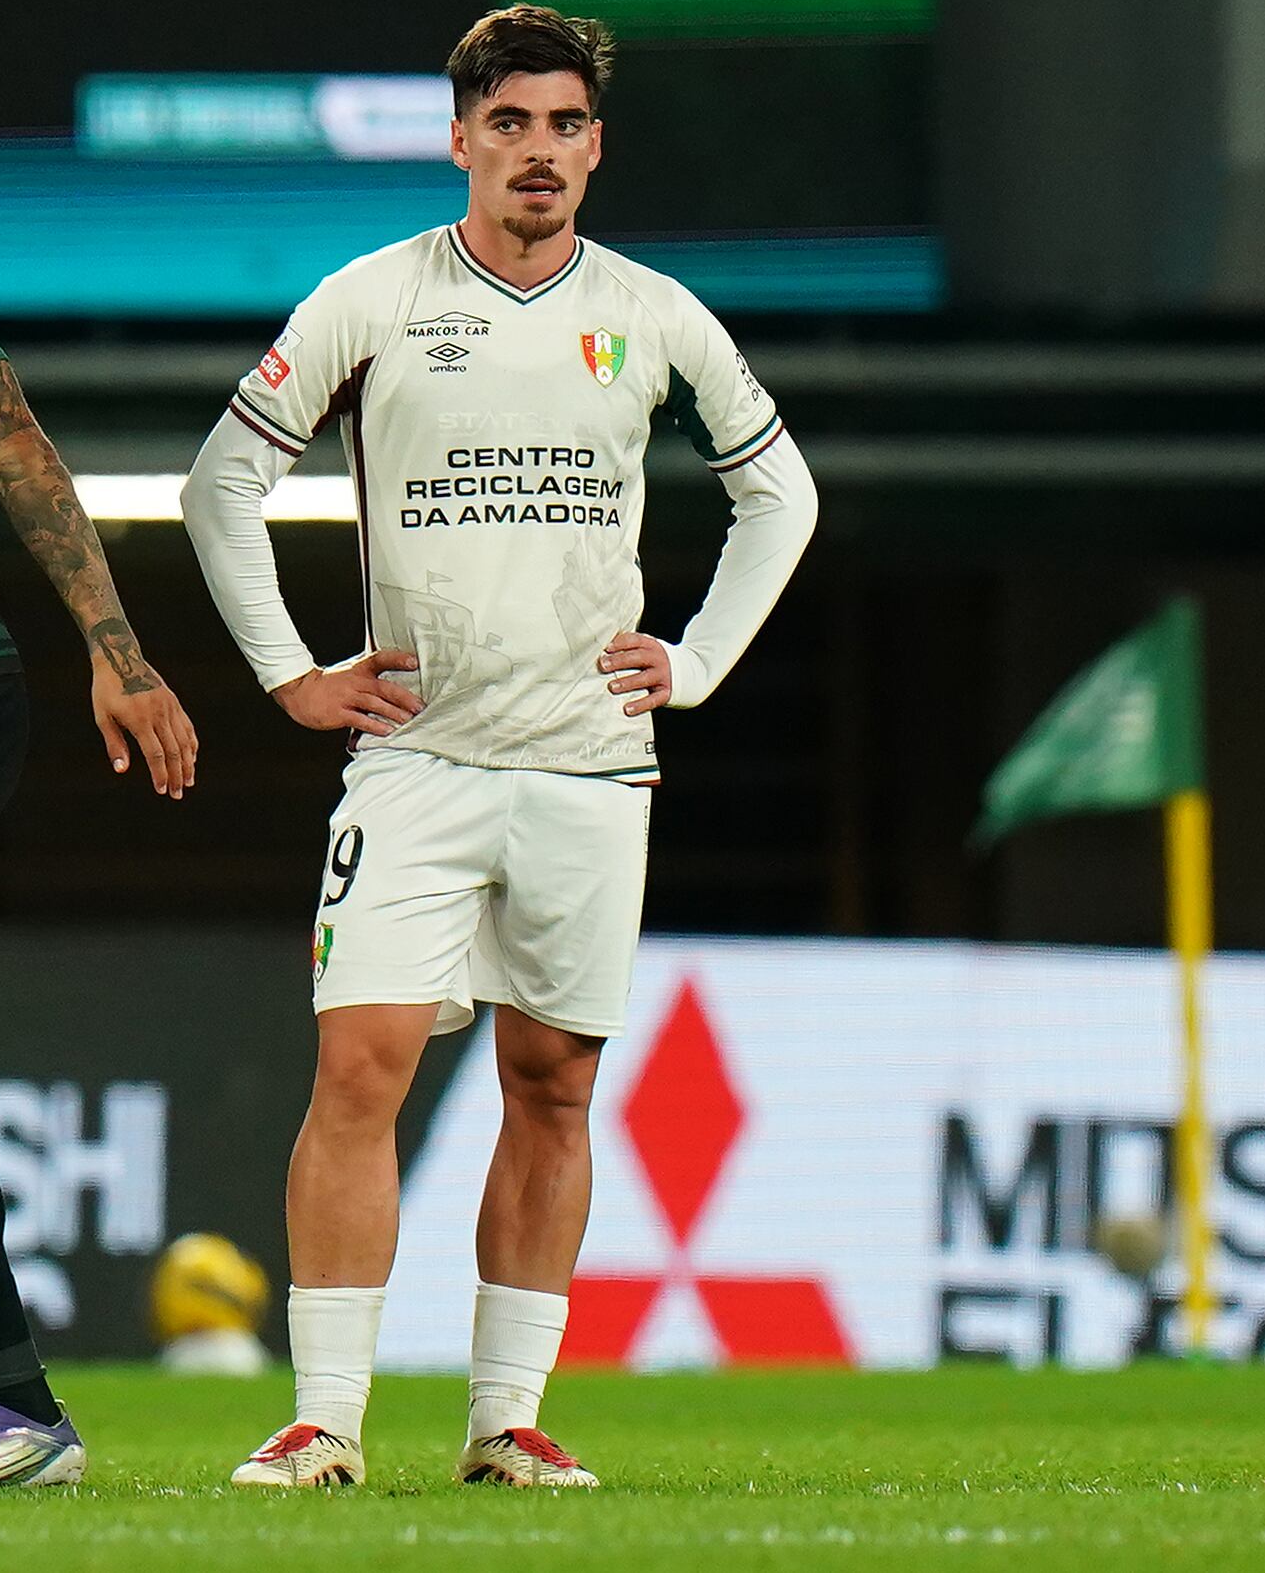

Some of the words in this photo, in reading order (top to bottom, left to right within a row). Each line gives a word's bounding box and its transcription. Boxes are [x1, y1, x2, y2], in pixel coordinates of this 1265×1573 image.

[407, 326, 459, 338] MARCOS
[465, 325, 490, 337] CAR
[429, 364, 467, 373] umbro
[447, 447, 595, 468] CENTRO
[406, 475, 623, 499] RECICLAGEM
[401, 508, 449, 528] DA
[457, 504, 621, 528] AMADORA
